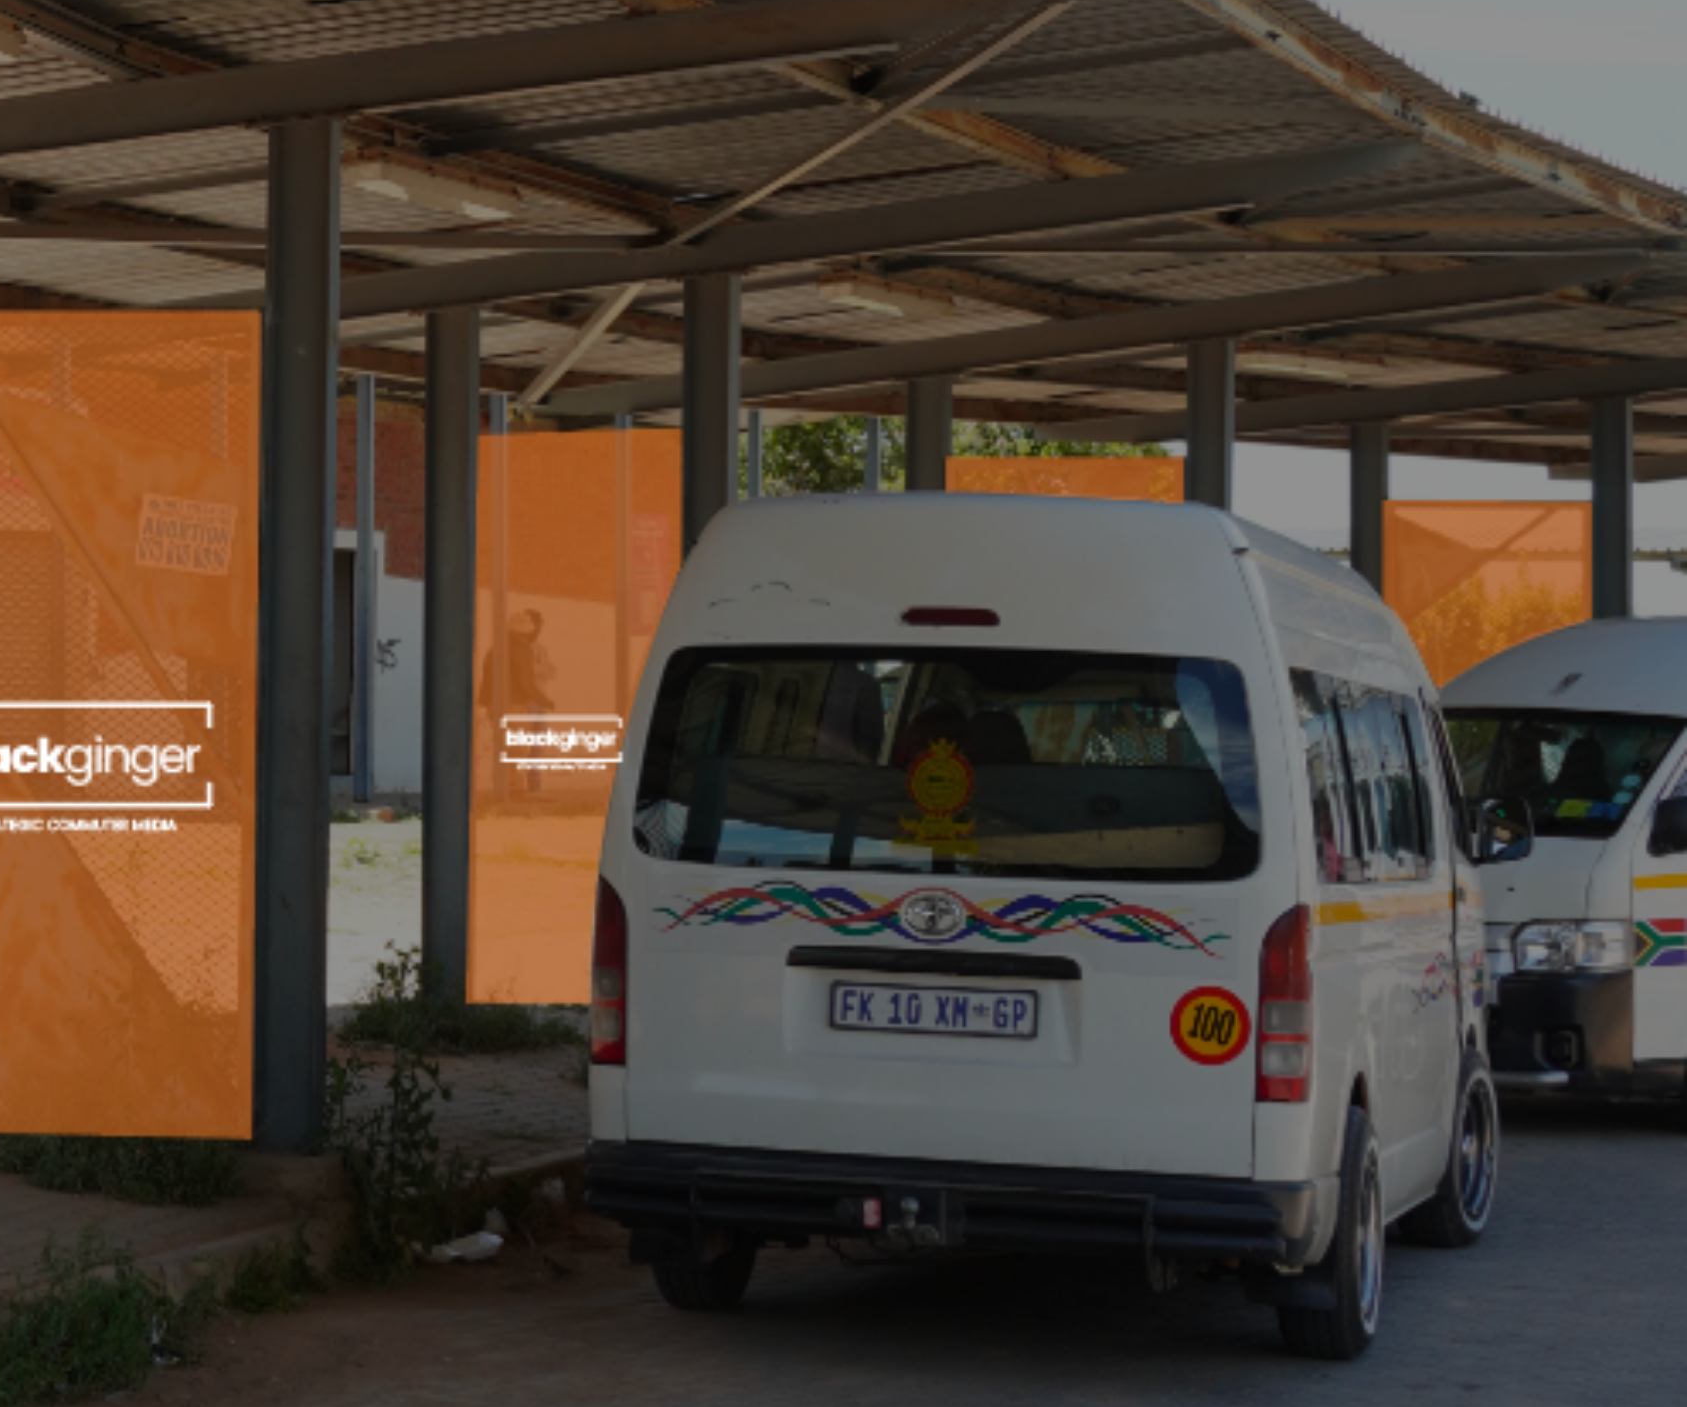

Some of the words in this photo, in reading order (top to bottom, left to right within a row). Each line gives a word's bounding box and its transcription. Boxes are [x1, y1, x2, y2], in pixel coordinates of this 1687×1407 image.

[840, 989, 874, 1023] FK
[887, 993, 922, 1025] 10
[934, 995, 969, 1028] XM
[993, 998, 1027, 1030] GP
[1188, 1003, 1236, 1045] 100
